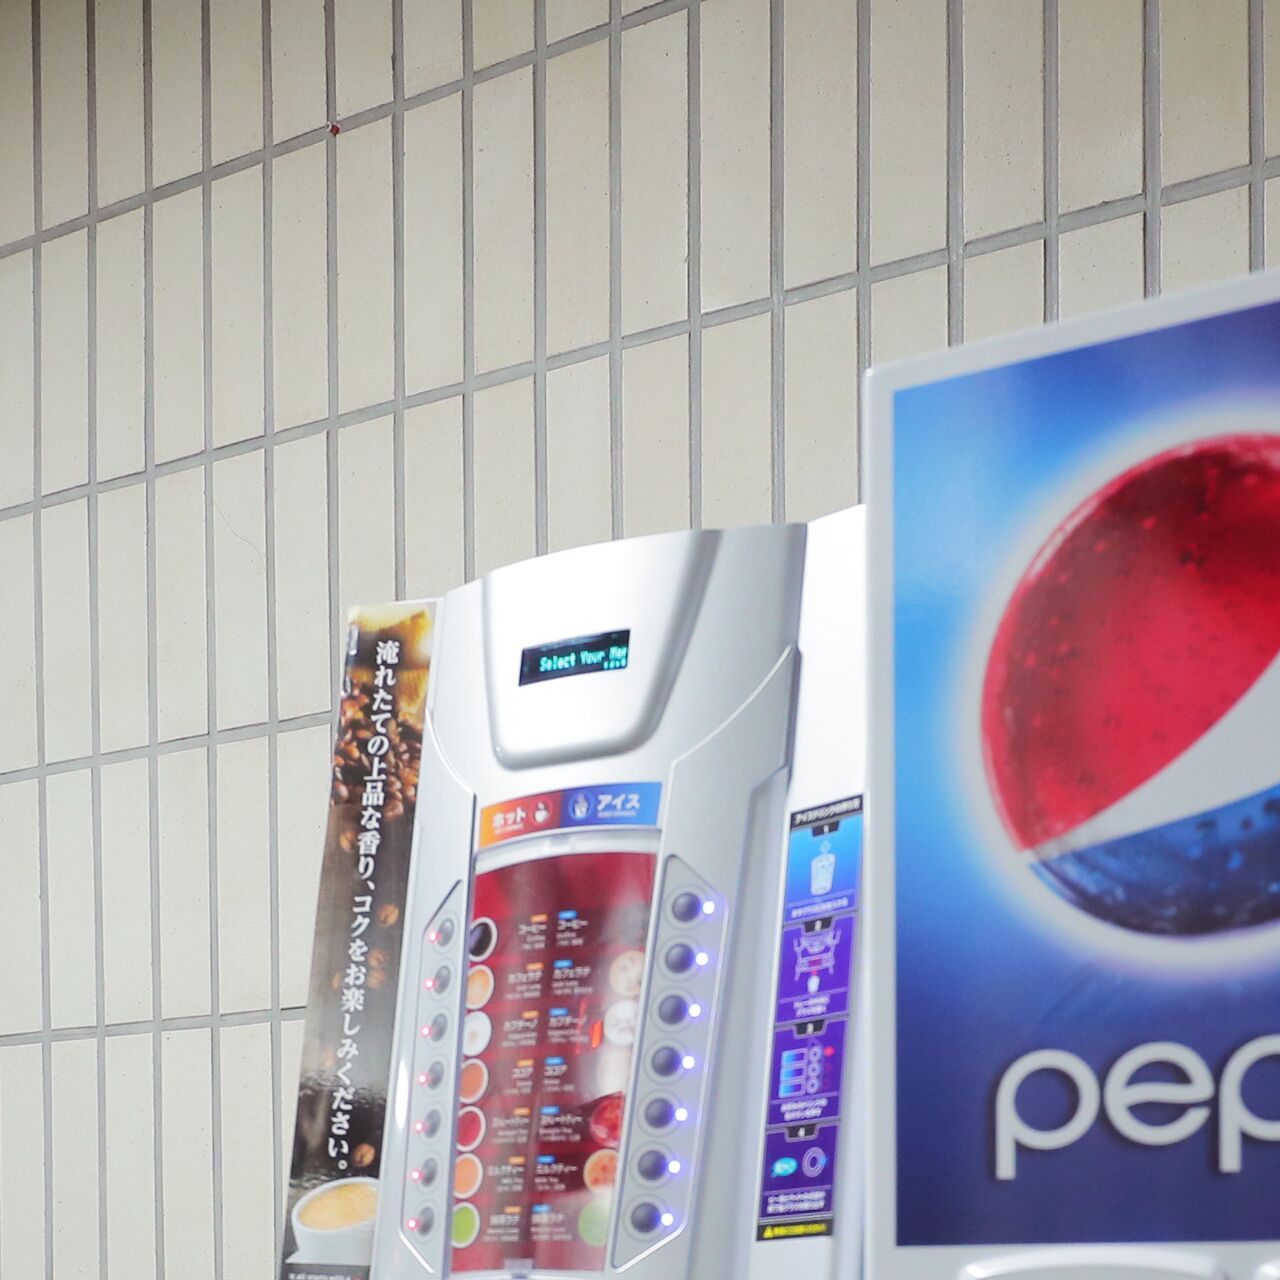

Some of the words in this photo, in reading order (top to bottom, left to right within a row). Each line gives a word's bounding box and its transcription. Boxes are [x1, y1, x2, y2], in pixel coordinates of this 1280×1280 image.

[539, 652, 576, 672] Select
[580, 650, 605, 665] Your
[597, 793, 641, 811] アイス
[492, 806, 527, 828] ホット
[327, 640, 401, 1172] 淹れたての上品な香り、コクをお楽しみください。
